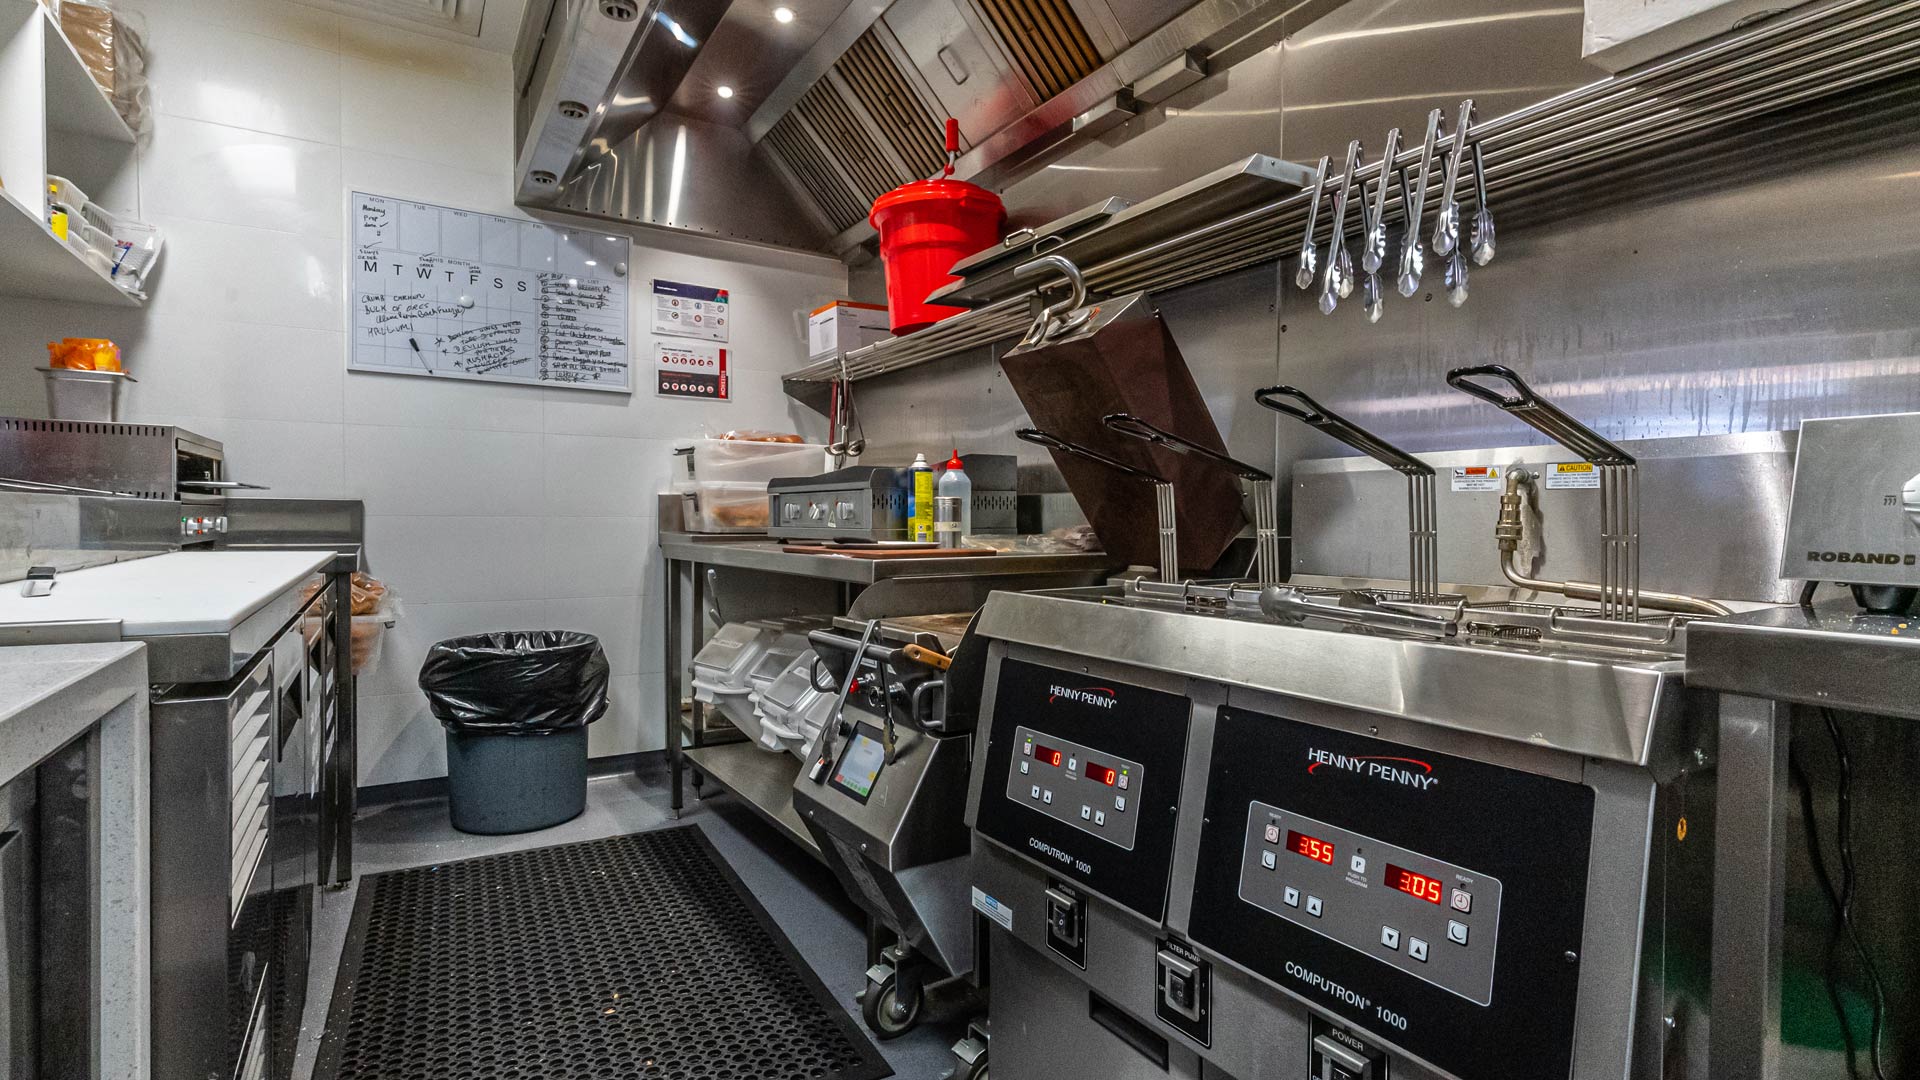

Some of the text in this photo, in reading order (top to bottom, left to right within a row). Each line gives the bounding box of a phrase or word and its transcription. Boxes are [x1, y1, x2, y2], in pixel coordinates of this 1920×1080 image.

[362, 204, 386, 217] Monday
[364, 260, 527, 292] M T W T F S S
[1566, 463, 1591, 471] CAUTION
[1807, 551, 1900, 564] ROBAND
[1050, 684, 1115, 709] HENNY PENNY
[1053, 752, 1061, 765] 0
[1308, 747, 1433, 790] HENNY PENNY
[1106, 770, 1114, 784] 0
[1029, 837, 1091, 875] COMPUTRON 1000
[1355, 860, 1361, 868] P
[1455, 874, 1473, 883] READY
[1166, 941, 1184, 955] FILTER
[1285, 961, 1407, 1030] COMPUTRON 1000
[1332, 1028, 1364, 1052] POWER
